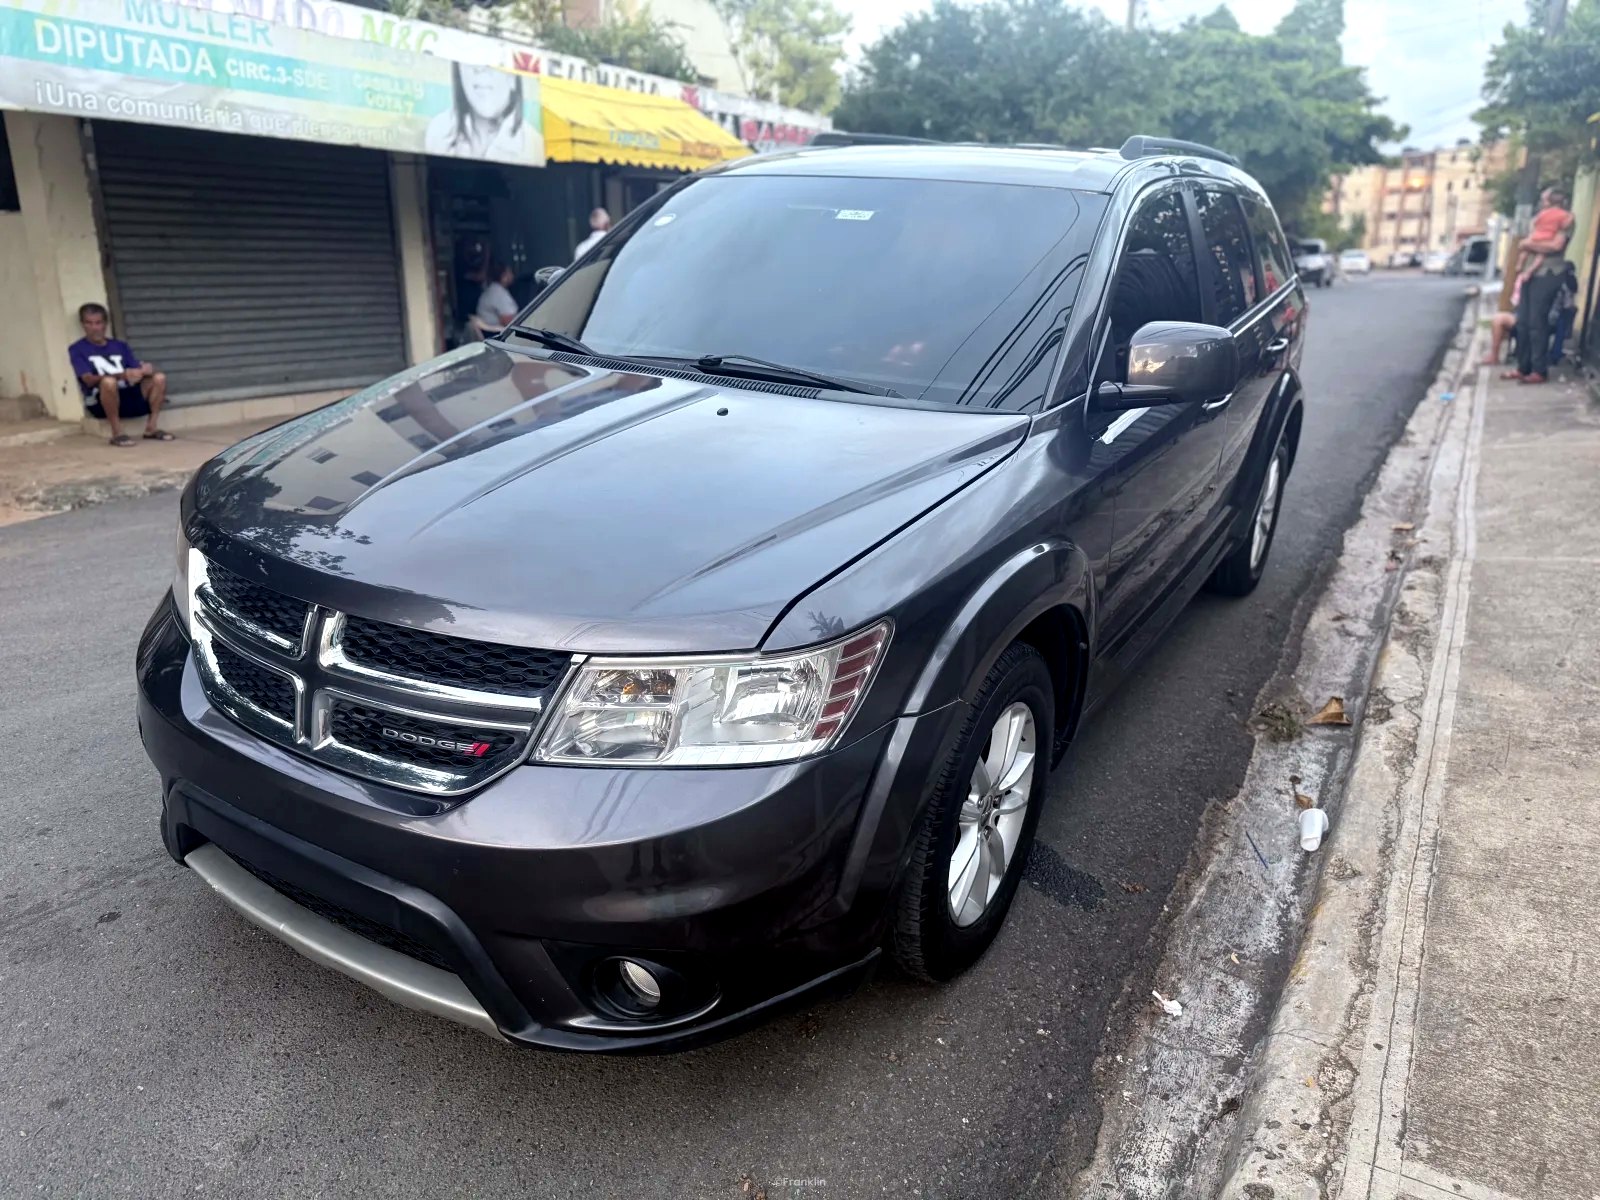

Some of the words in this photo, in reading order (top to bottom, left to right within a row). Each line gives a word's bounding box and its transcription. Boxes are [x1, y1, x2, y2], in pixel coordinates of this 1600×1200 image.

[34, 19, 217, 79] DIPUTADA
[106, 96, 243, 128] comunitaria
[248, 111, 287, 134] que
[88, 355, 124, 376] N
[382, 727, 475, 752] DODGE
